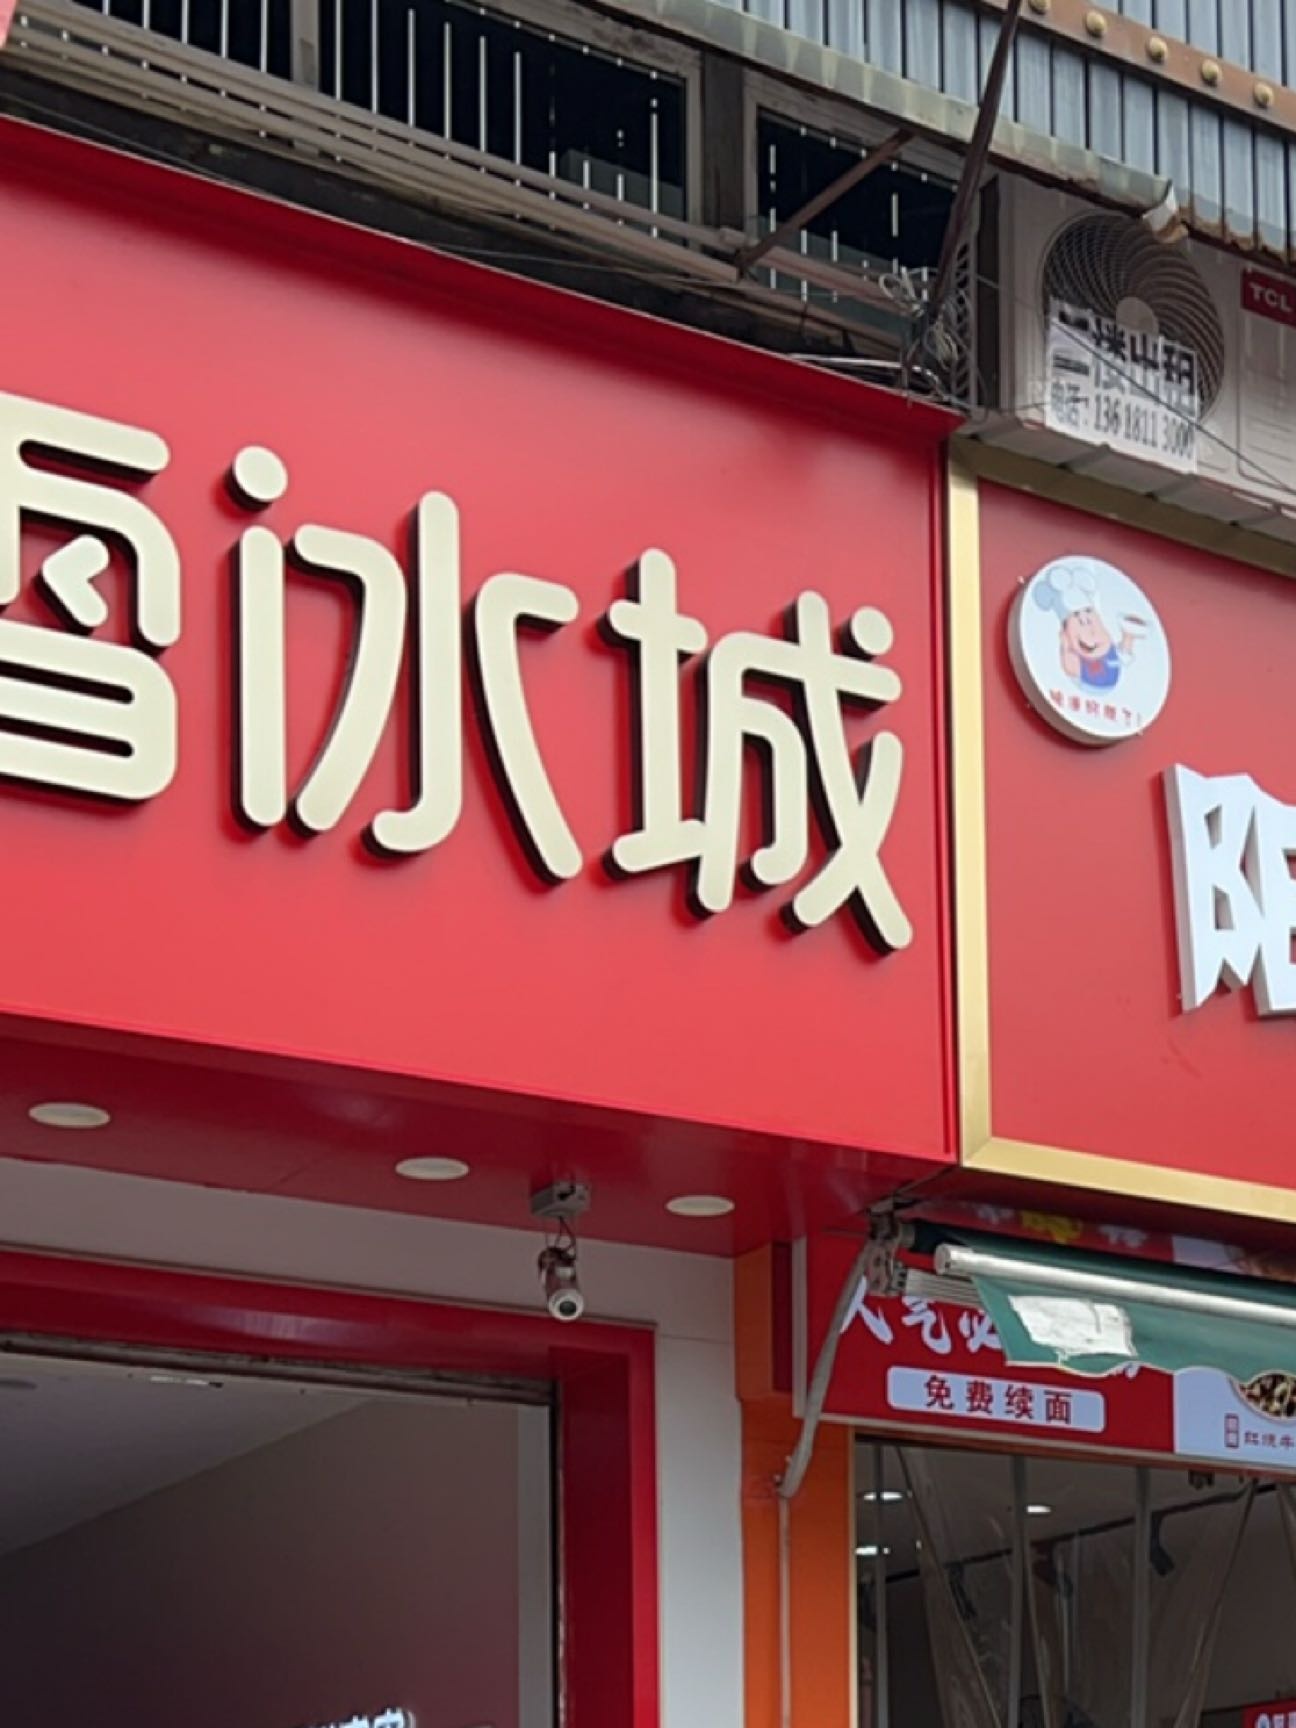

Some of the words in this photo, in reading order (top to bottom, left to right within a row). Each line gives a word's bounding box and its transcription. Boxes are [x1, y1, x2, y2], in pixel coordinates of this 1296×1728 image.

[1250, 280, 1293, 313] TCL
[841, 1276, 1001, 1355] 人气必
[924, 1375, 1073, 1426] 免费续面
